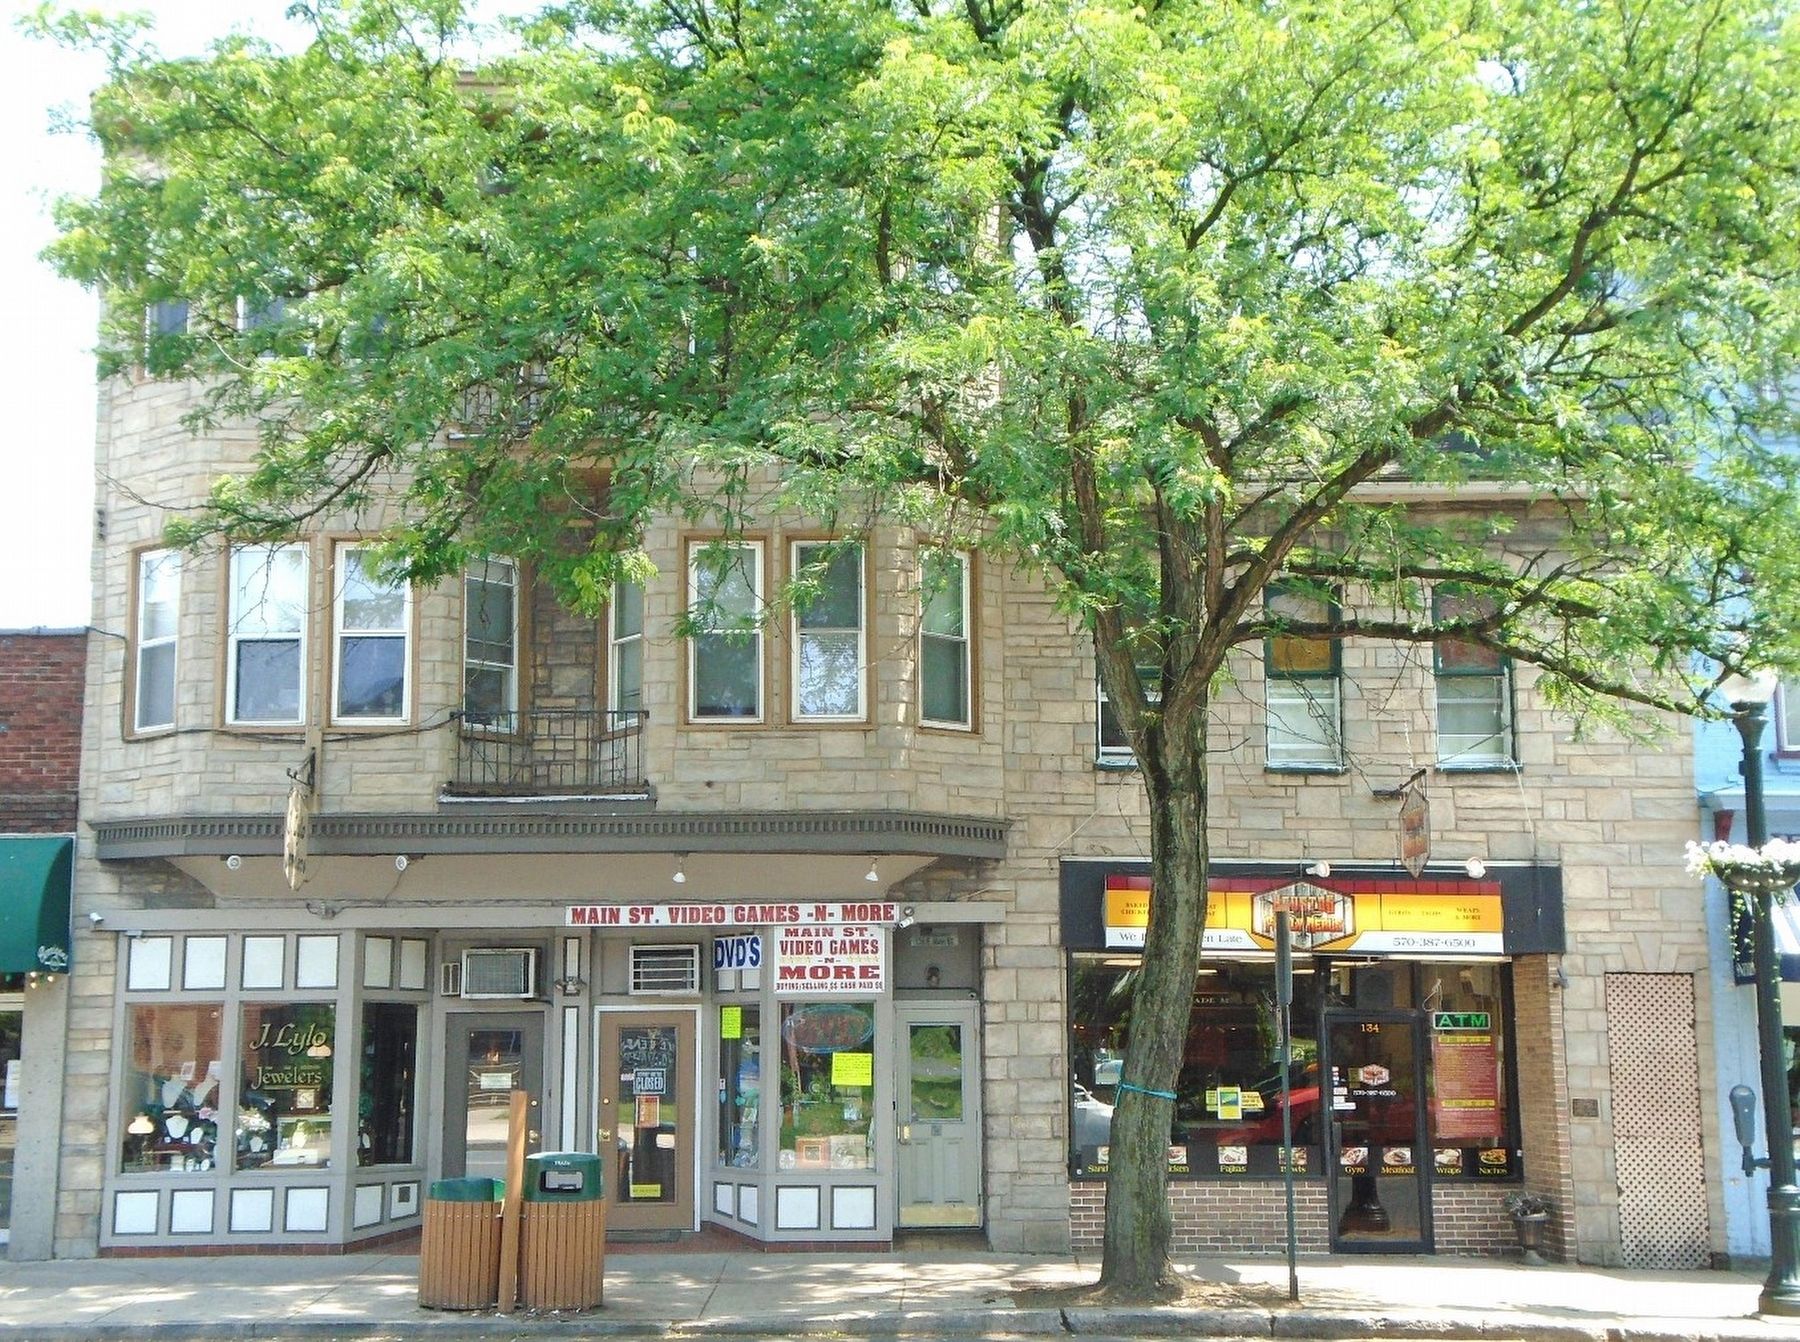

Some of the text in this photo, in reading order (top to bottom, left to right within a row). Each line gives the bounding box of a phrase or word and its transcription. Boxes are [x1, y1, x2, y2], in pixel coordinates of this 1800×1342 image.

[571, 904, 894, 924] MAIN ST. VIDEO GAMES -N- MORE
[784, 927, 874, 938] MAIN ST.
[1119, 932, 1137, 941] We
[1218, 934, 1243, 943] Late
[779, 940, 879, 956] VIDEO GAMES
[1393, 937, 1476, 948] 570-387-6500
[714, 936, 761, 969] DVD'S
[779, 965, 880, 980] MORE
[840, 981, 856, 990] CASH
[859, 981, 874, 990] PAID
[1440, 1014, 1486, 1027] ATM
[1361, 1023, 1380, 1033] 134
[249, 1022, 327, 1055] J. Lylo
[250, 1066, 322, 1090] Jewelers
[635, 1076, 664, 1090] CLOSED
[1220, 1165, 1247, 1174] Fajitas
[1344, 1166, 1366, 1175] Gyro
[1381, 1165, 1416, 1174] Meatloaf
[1436, 1166, 1462, 1175] Wraps
